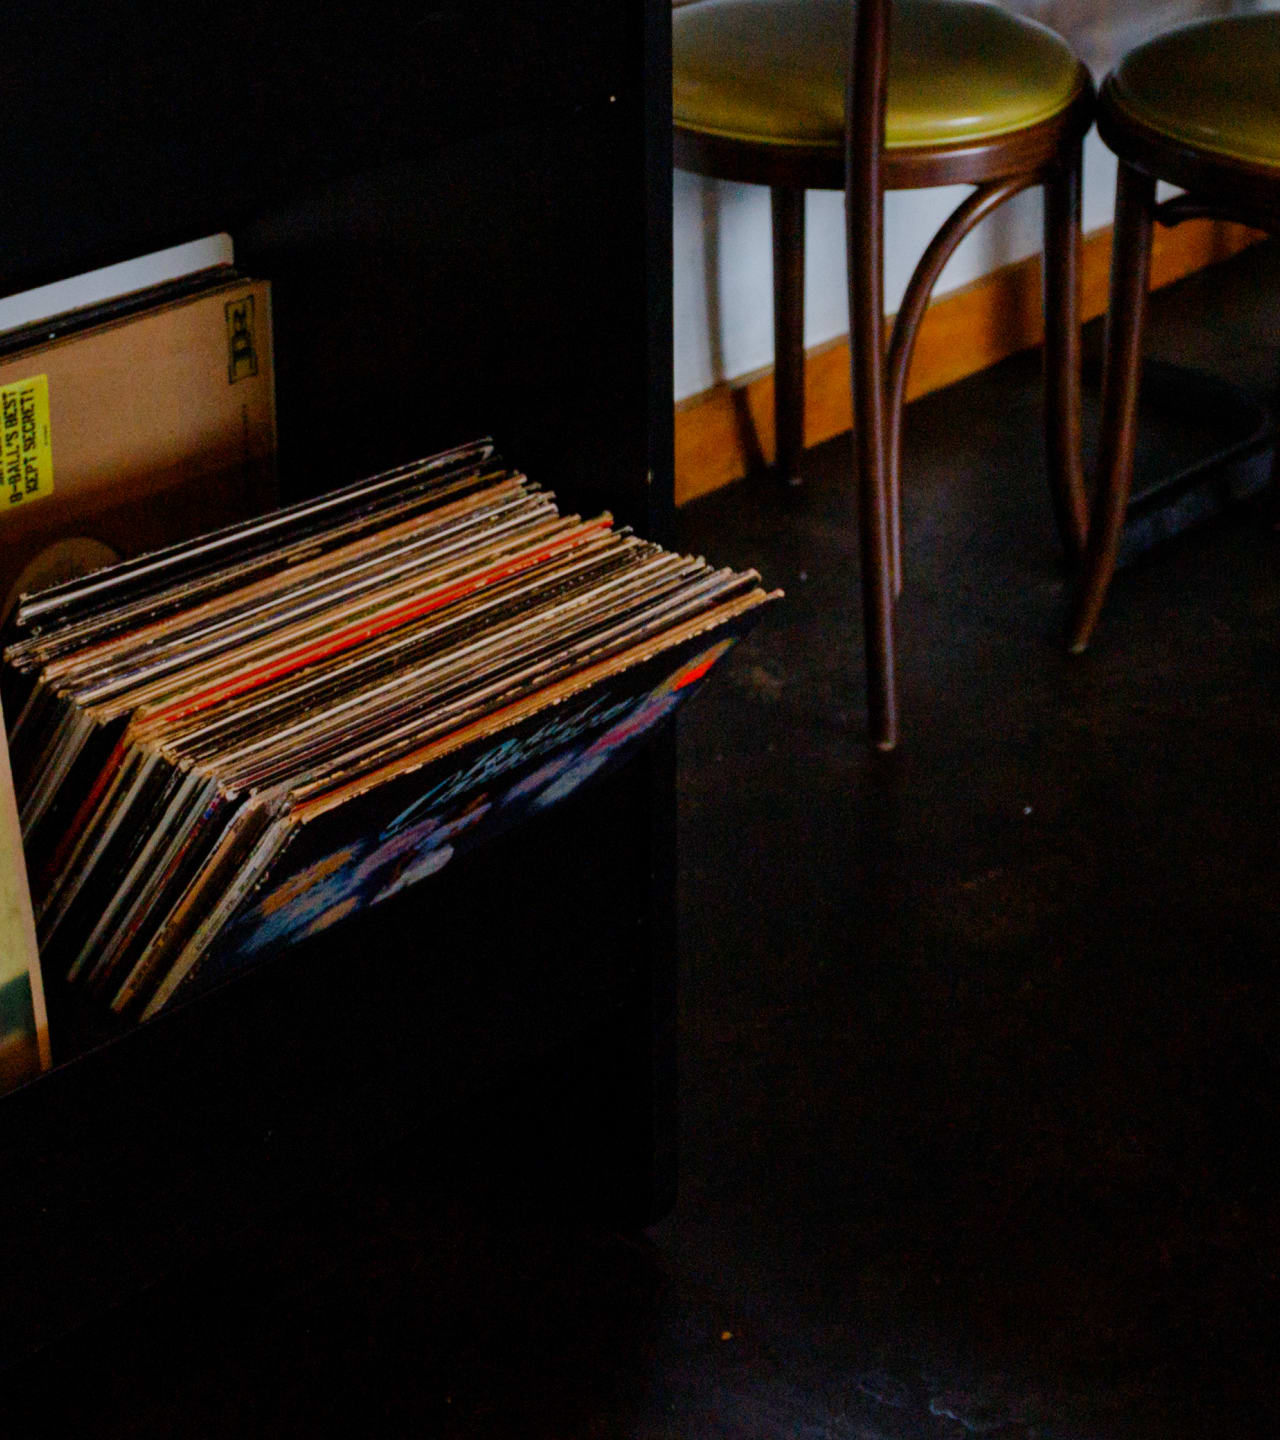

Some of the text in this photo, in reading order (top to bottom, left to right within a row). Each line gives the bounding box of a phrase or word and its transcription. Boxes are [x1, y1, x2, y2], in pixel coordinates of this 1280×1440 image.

[2, 391, 18, 429] BEST
[20, 388, 39, 495] KEPT SECRET!
